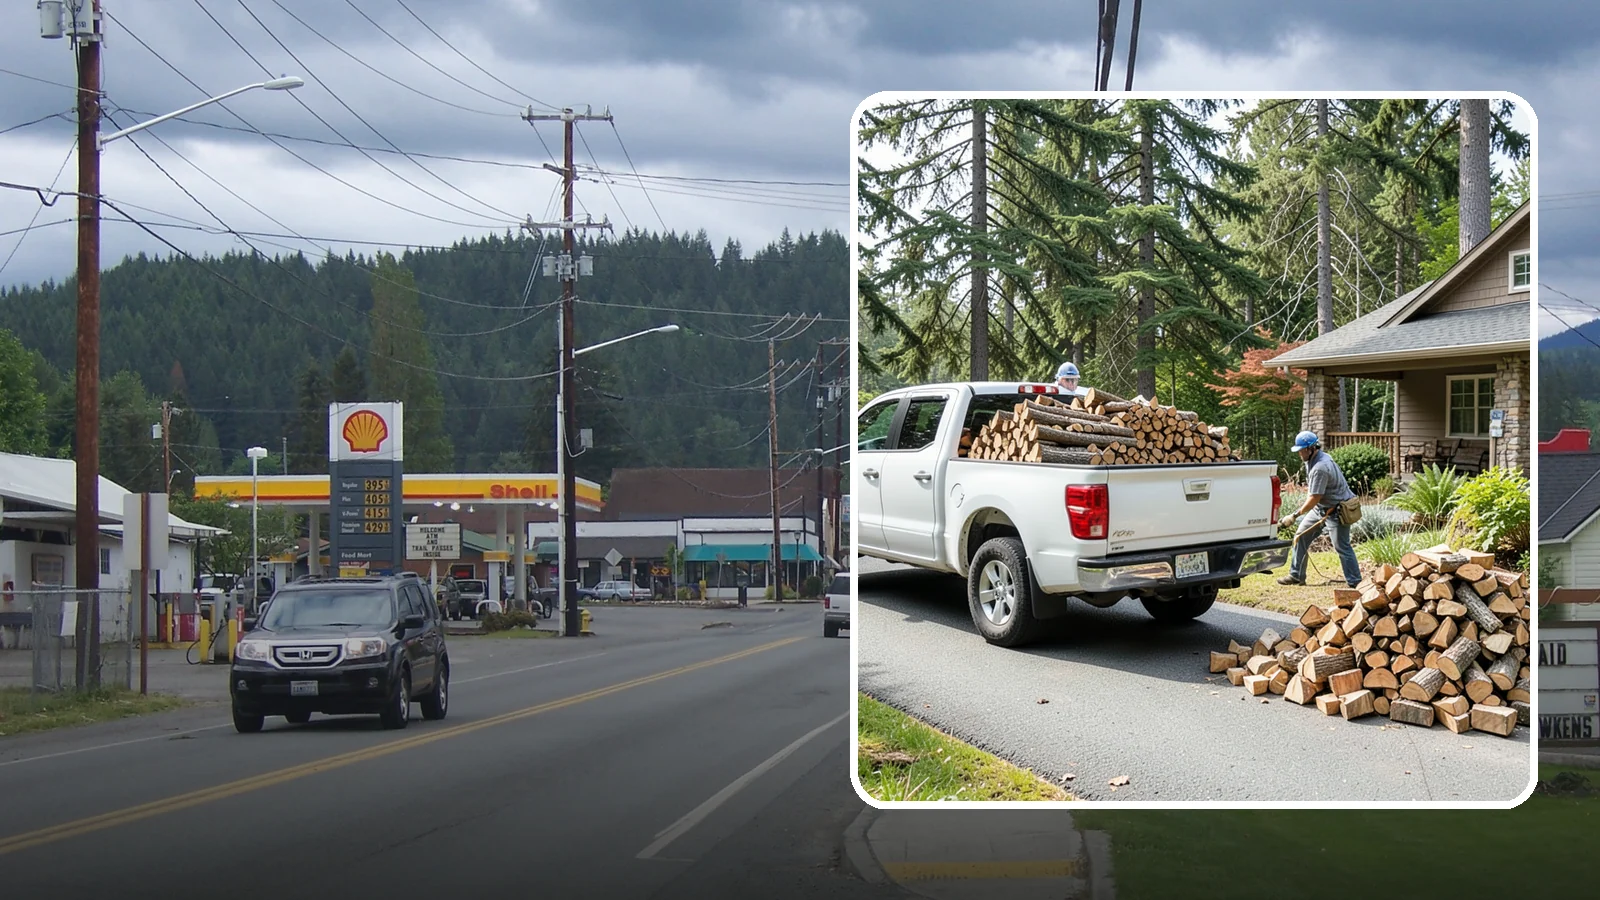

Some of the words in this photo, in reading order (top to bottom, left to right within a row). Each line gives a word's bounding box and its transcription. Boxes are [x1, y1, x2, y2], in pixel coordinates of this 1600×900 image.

[365, 480, 383, 490] 395
[490, 484, 547, 499] Shell
[365, 494, 383, 504] 405
[365, 508, 383, 518] 415
[365, 522, 383, 532] 429
[1539, 643, 1566, 665] AID
